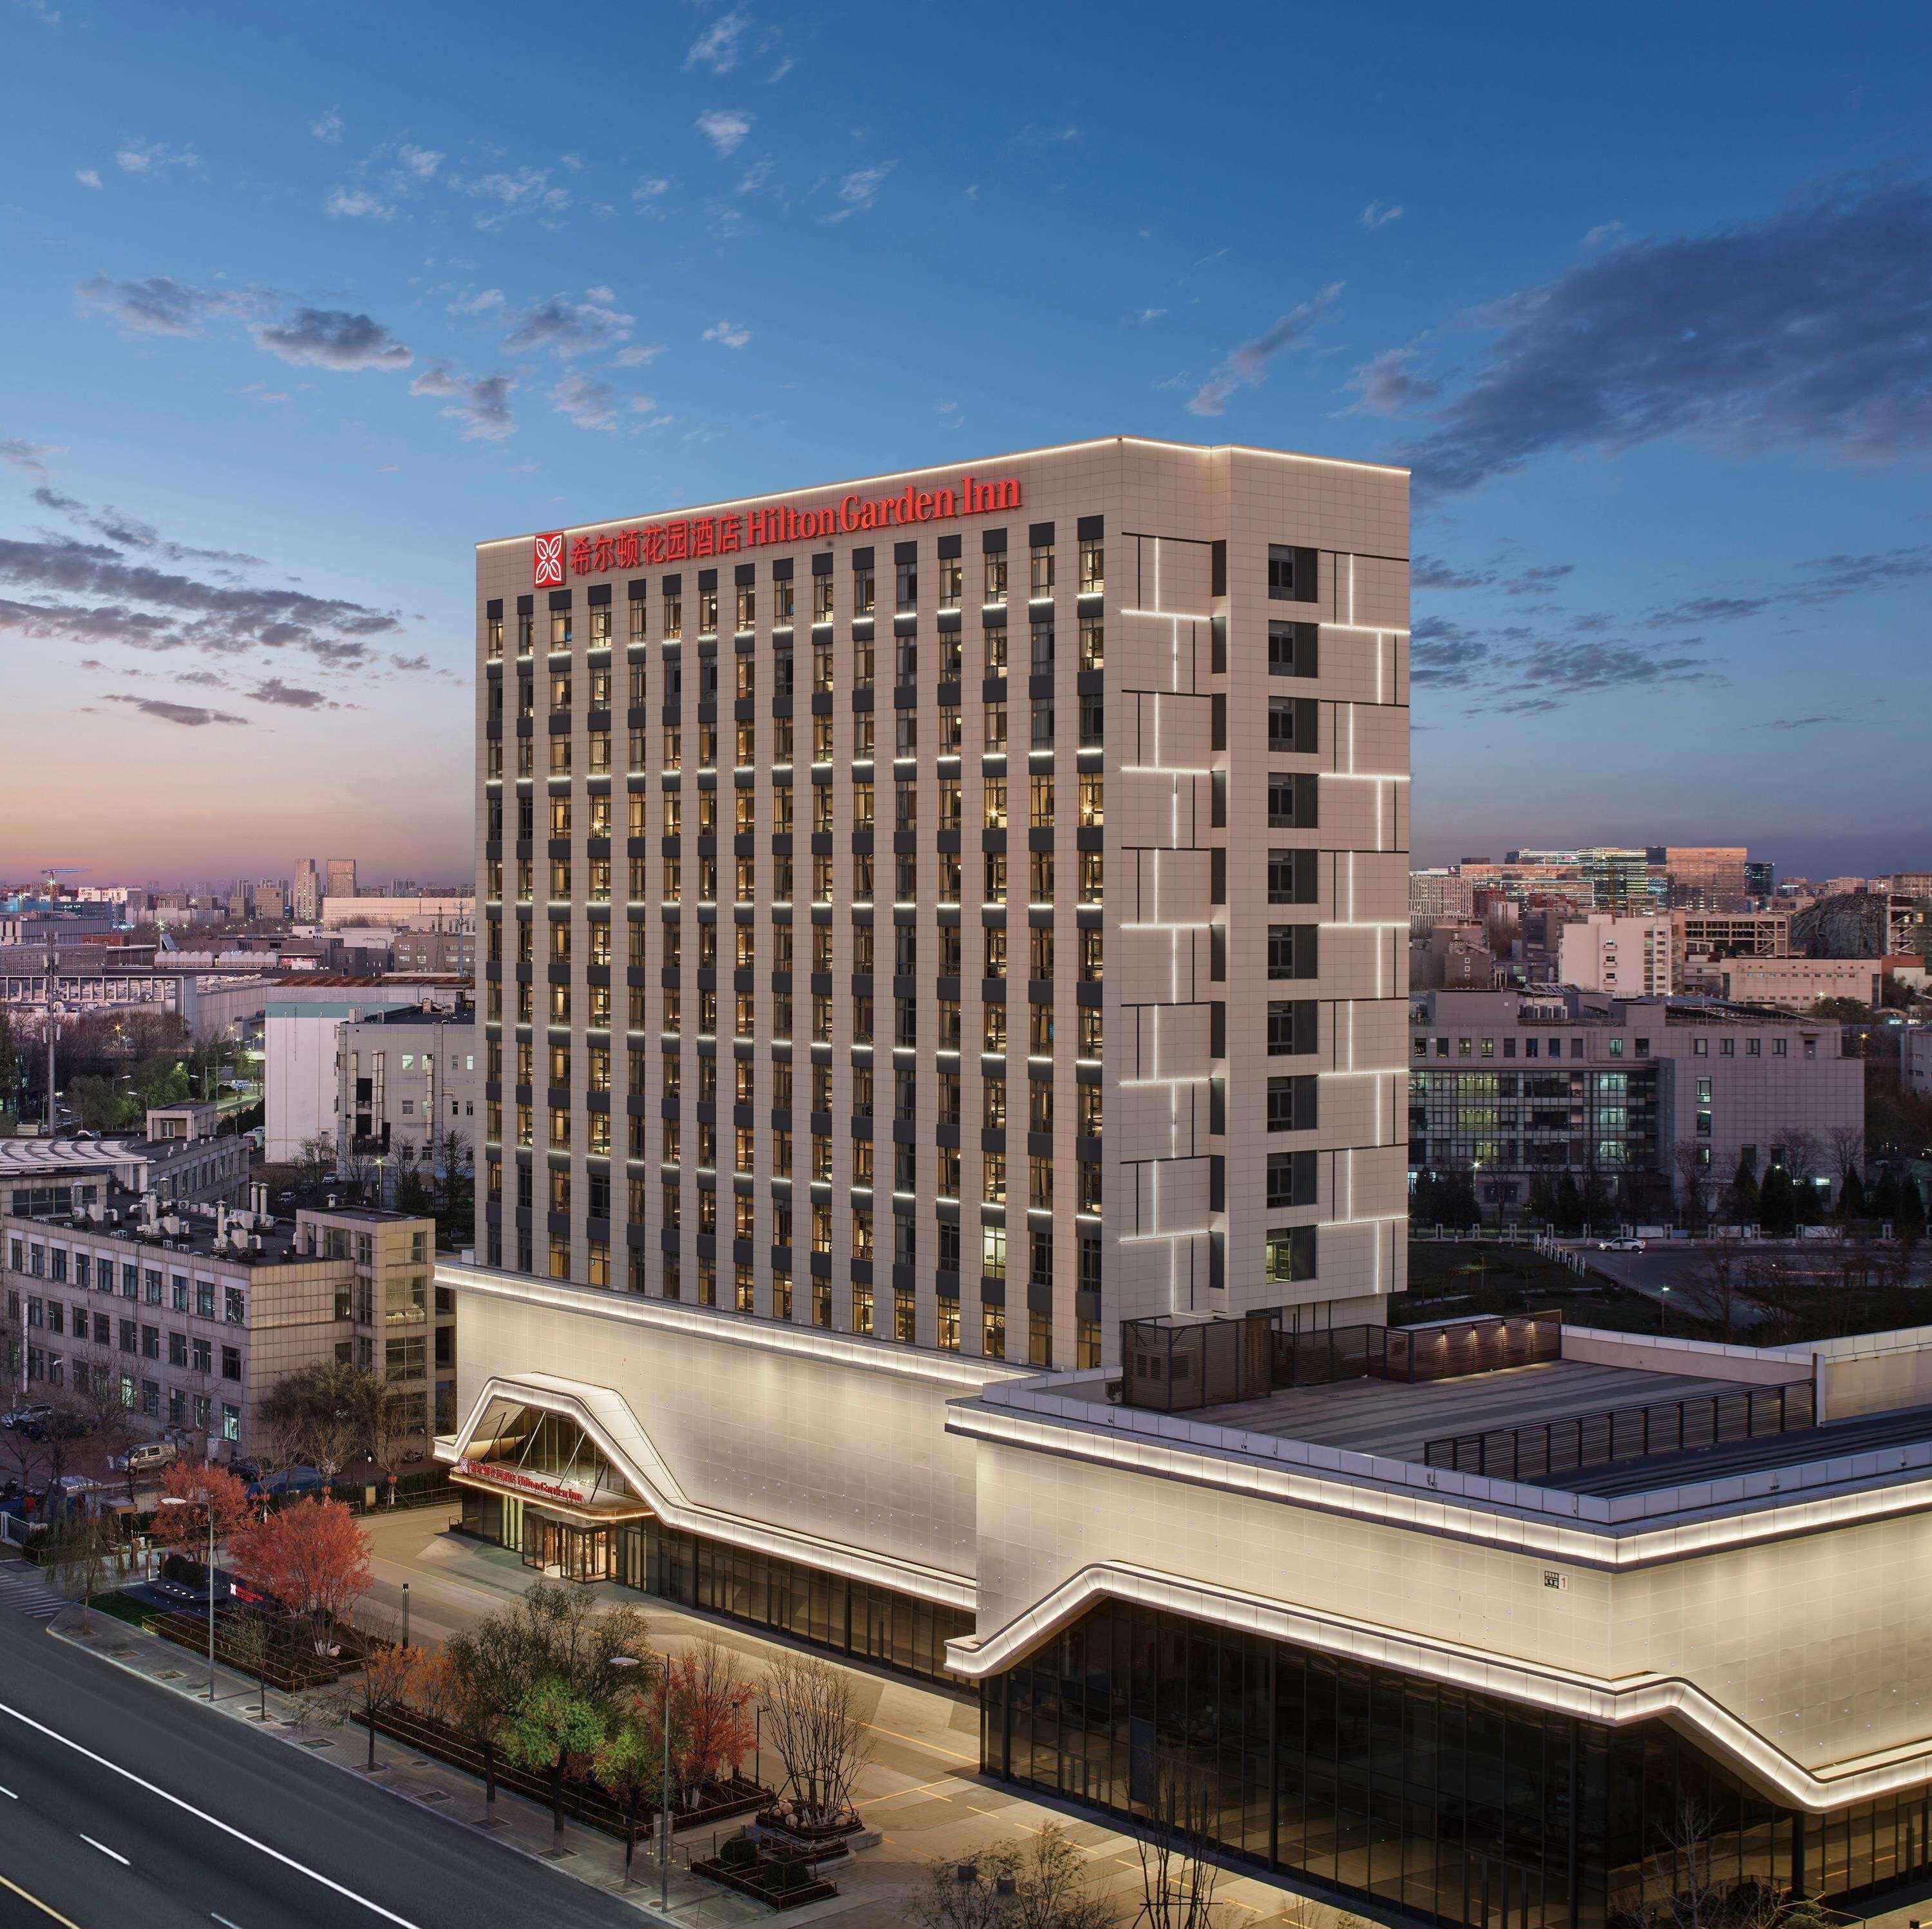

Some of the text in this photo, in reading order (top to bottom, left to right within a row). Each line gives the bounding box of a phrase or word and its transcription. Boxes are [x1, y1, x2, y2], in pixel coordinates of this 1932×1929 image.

[571, 511, 741, 575] 希尔顿花园酒店
[747, 476, 1021, 546] Hilton Garden Inn
[1561, 1577, 1566, 1588] 1
